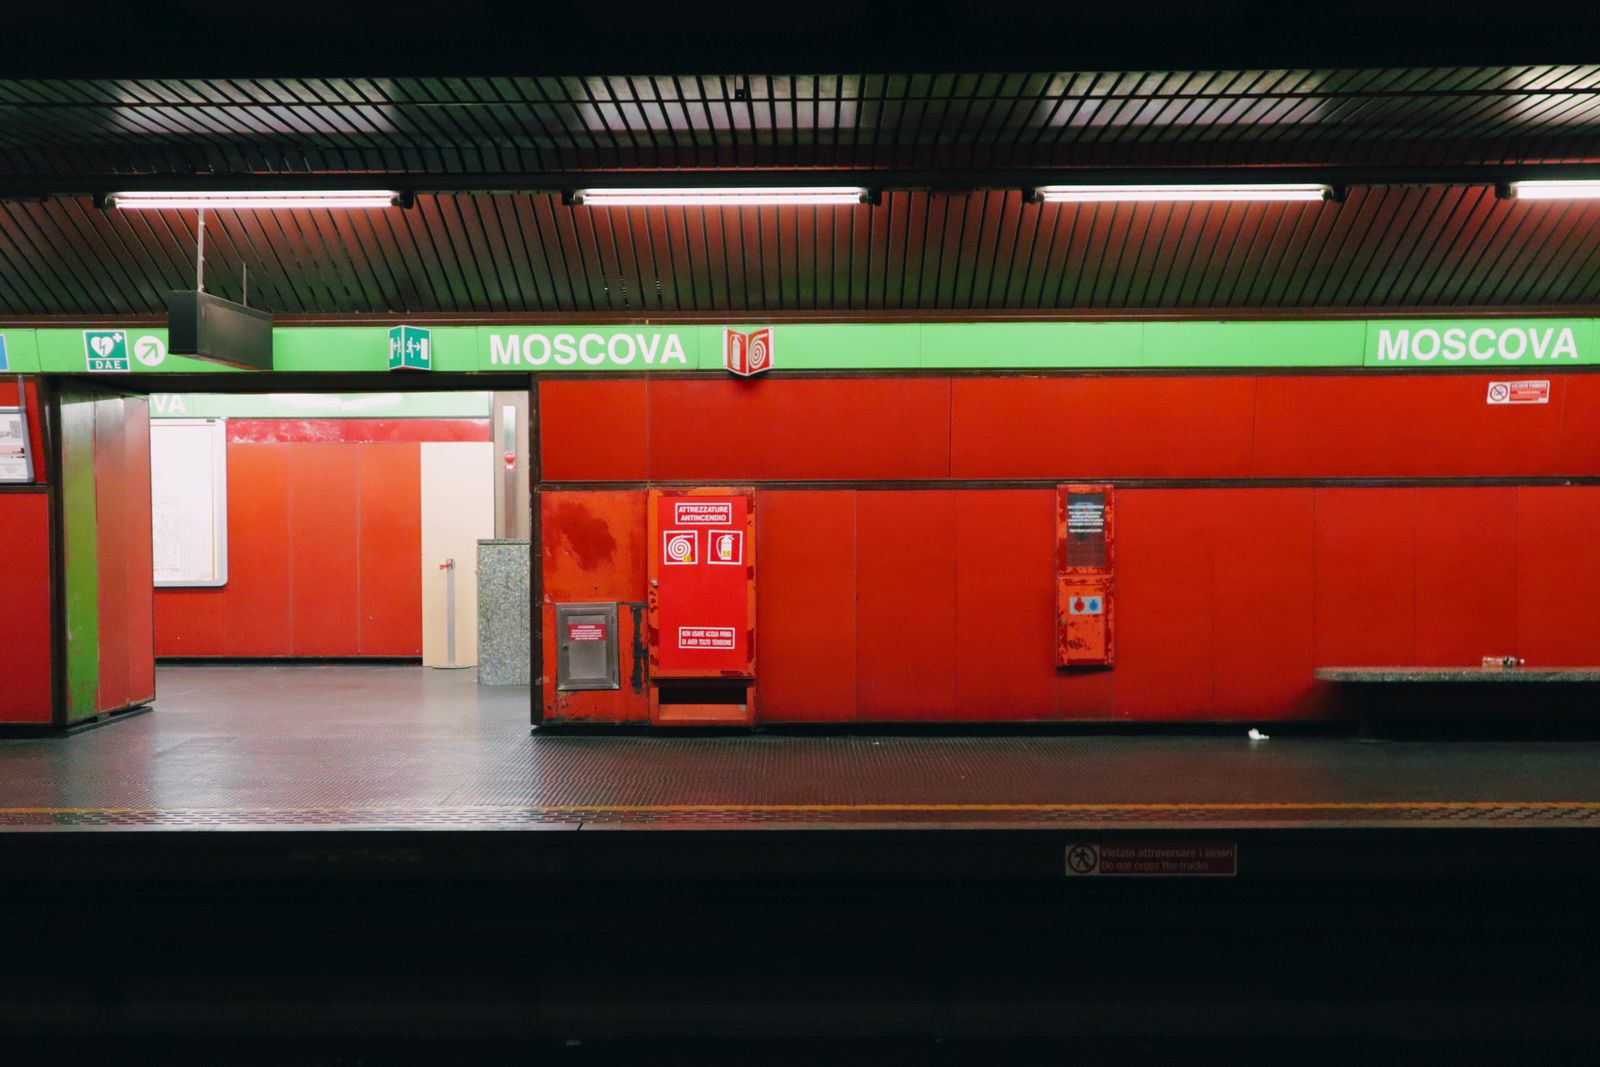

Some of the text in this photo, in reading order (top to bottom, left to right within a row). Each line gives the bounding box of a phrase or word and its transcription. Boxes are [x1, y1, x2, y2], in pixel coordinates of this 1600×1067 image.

[490, 334, 687, 365] MOSCOVA
[1377, 328, 1579, 361] MOSCOVA
[95, 360, 122, 369] DAE
[149, 394, 186, 413] VA
[1101, 847, 1136, 858] Vietato
[1138, 847, 1197, 858] attraversare
[1205, 847, 1233, 858] binari
[1101, 860, 1209, 870] Do not cross the tracks
